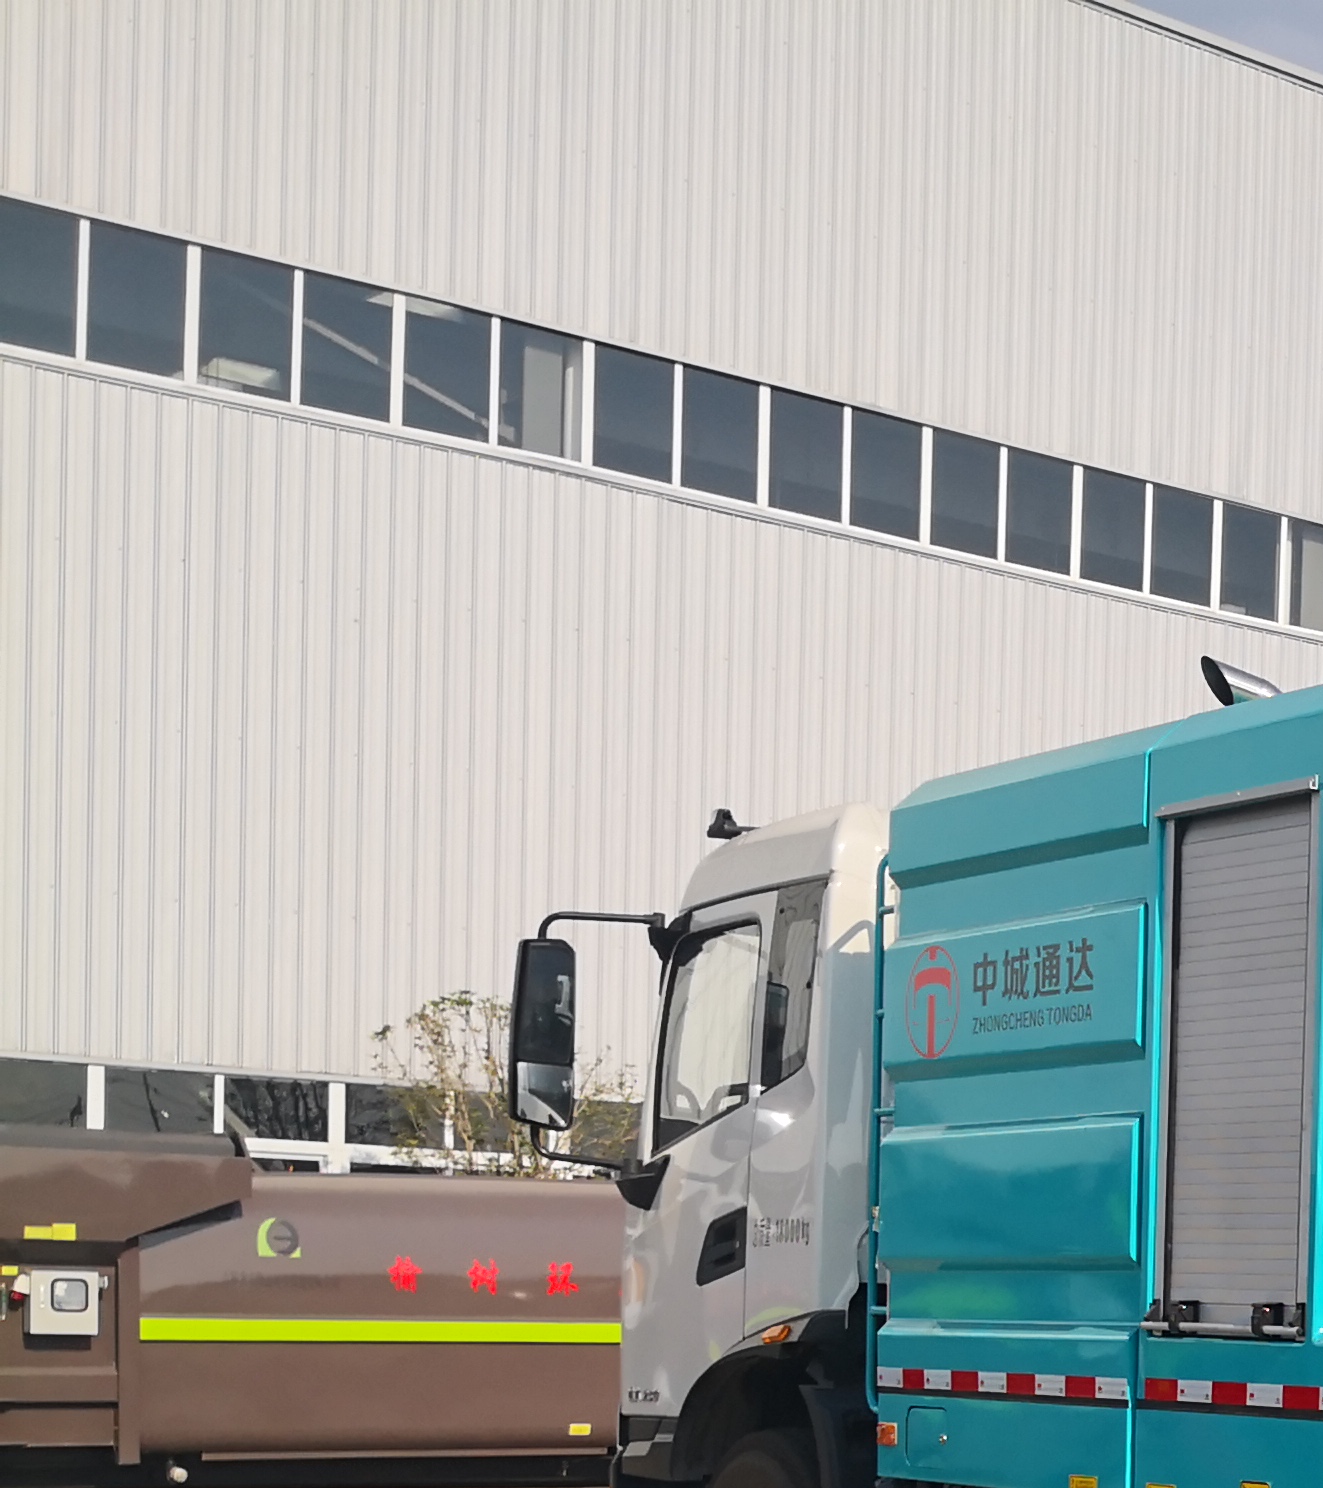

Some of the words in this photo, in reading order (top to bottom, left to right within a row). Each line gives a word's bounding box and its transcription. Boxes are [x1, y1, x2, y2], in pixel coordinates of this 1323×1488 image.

[973, 937, 1094, 1006] 中城通达
[972, 1008, 1045, 1034] ZHONGCHENG
[1047, 1004, 1092, 1025] TONGDA
